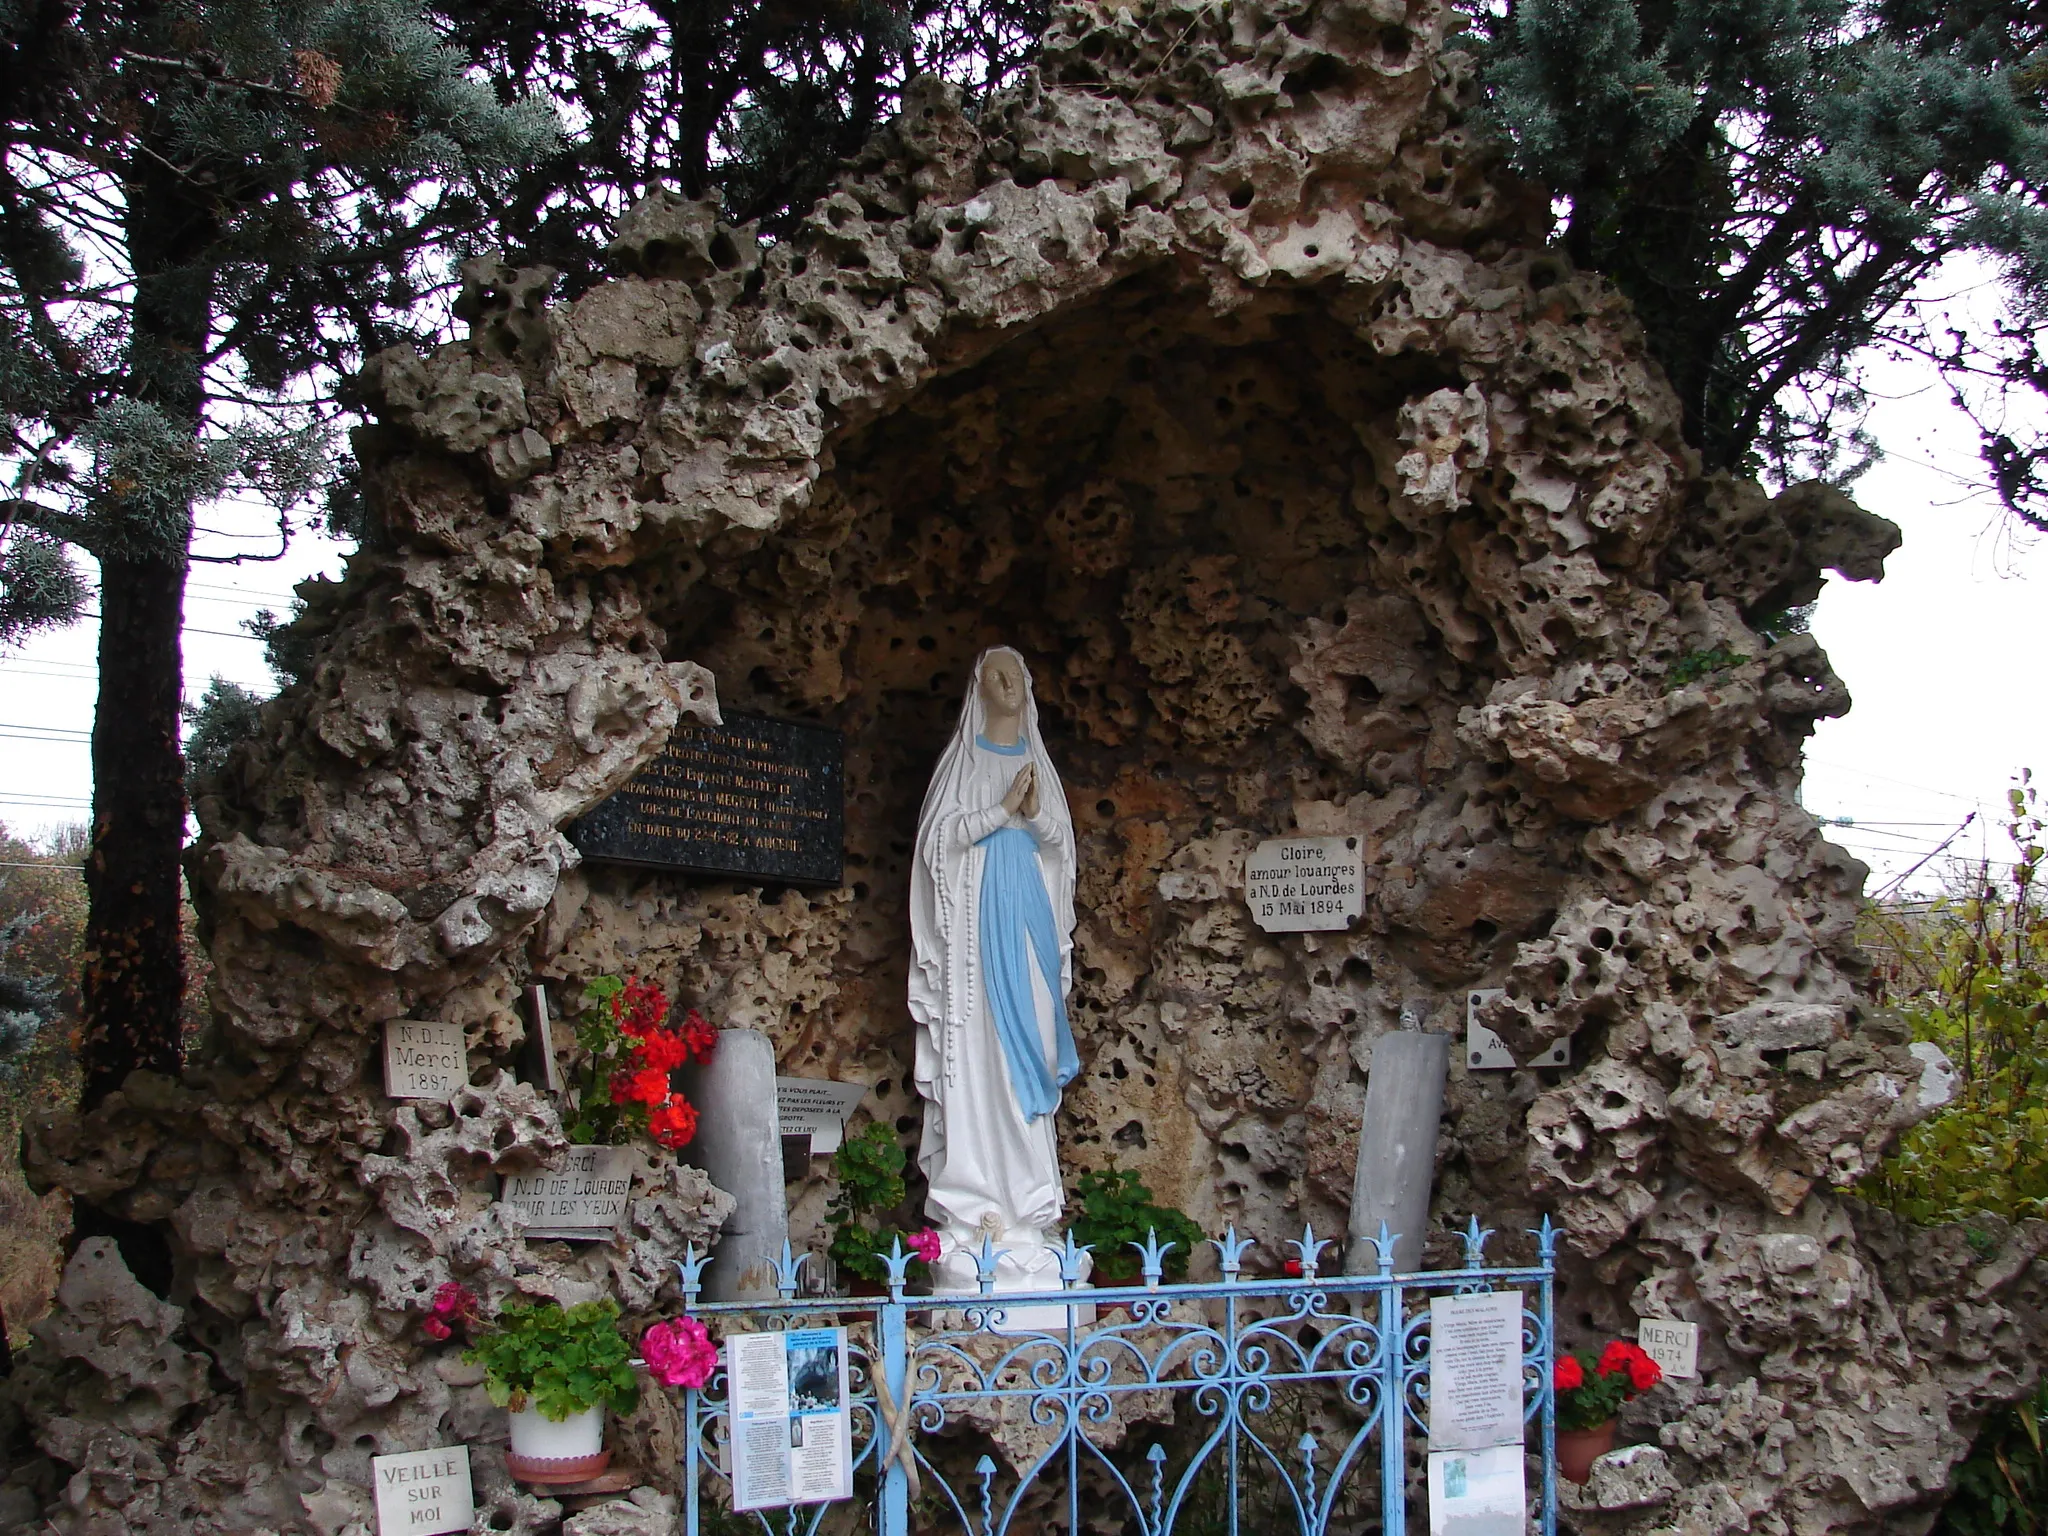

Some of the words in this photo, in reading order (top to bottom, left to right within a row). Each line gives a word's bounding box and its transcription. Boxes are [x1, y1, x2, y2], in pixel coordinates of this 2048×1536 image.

[640, 803, 665, 815] LORS
[670, 806, 683, 818] DE
[628, 822, 642, 833] EN
[647, 823, 672, 837] DATE
[677, 827, 690, 840] DU
[1281, 845, 1327, 862] Gloire,
[1250, 869, 1292, 881] amour
[1295, 865, 1356, 883] louanges
[1282, 884, 1297, 897] de
[1301, 882, 1356, 897] Lourdes
[1261, 903, 1274, 917] 15
[1279, 901, 1306, 916] Mai
[1311, 900, 1345, 914] 1894
[400, 1026, 457, 1046] N.D.L.
[395, 1047, 459, 1070] Merci
[550, 1180, 569, 1195] DE
[573, 1177, 628, 1196] LOURDES
[551, 1200, 577, 1216] LES
[583, 1200, 620, 1216] YEUX
[1642, 1327, 1689, 1348] MERCI
[1652, 1347, 1682, 1362] 1974
[383, 1460, 457, 1484] VEILLE
[408, 1485, 442, 1502] SUR
[410, 1507, 441, 1524] MOI
